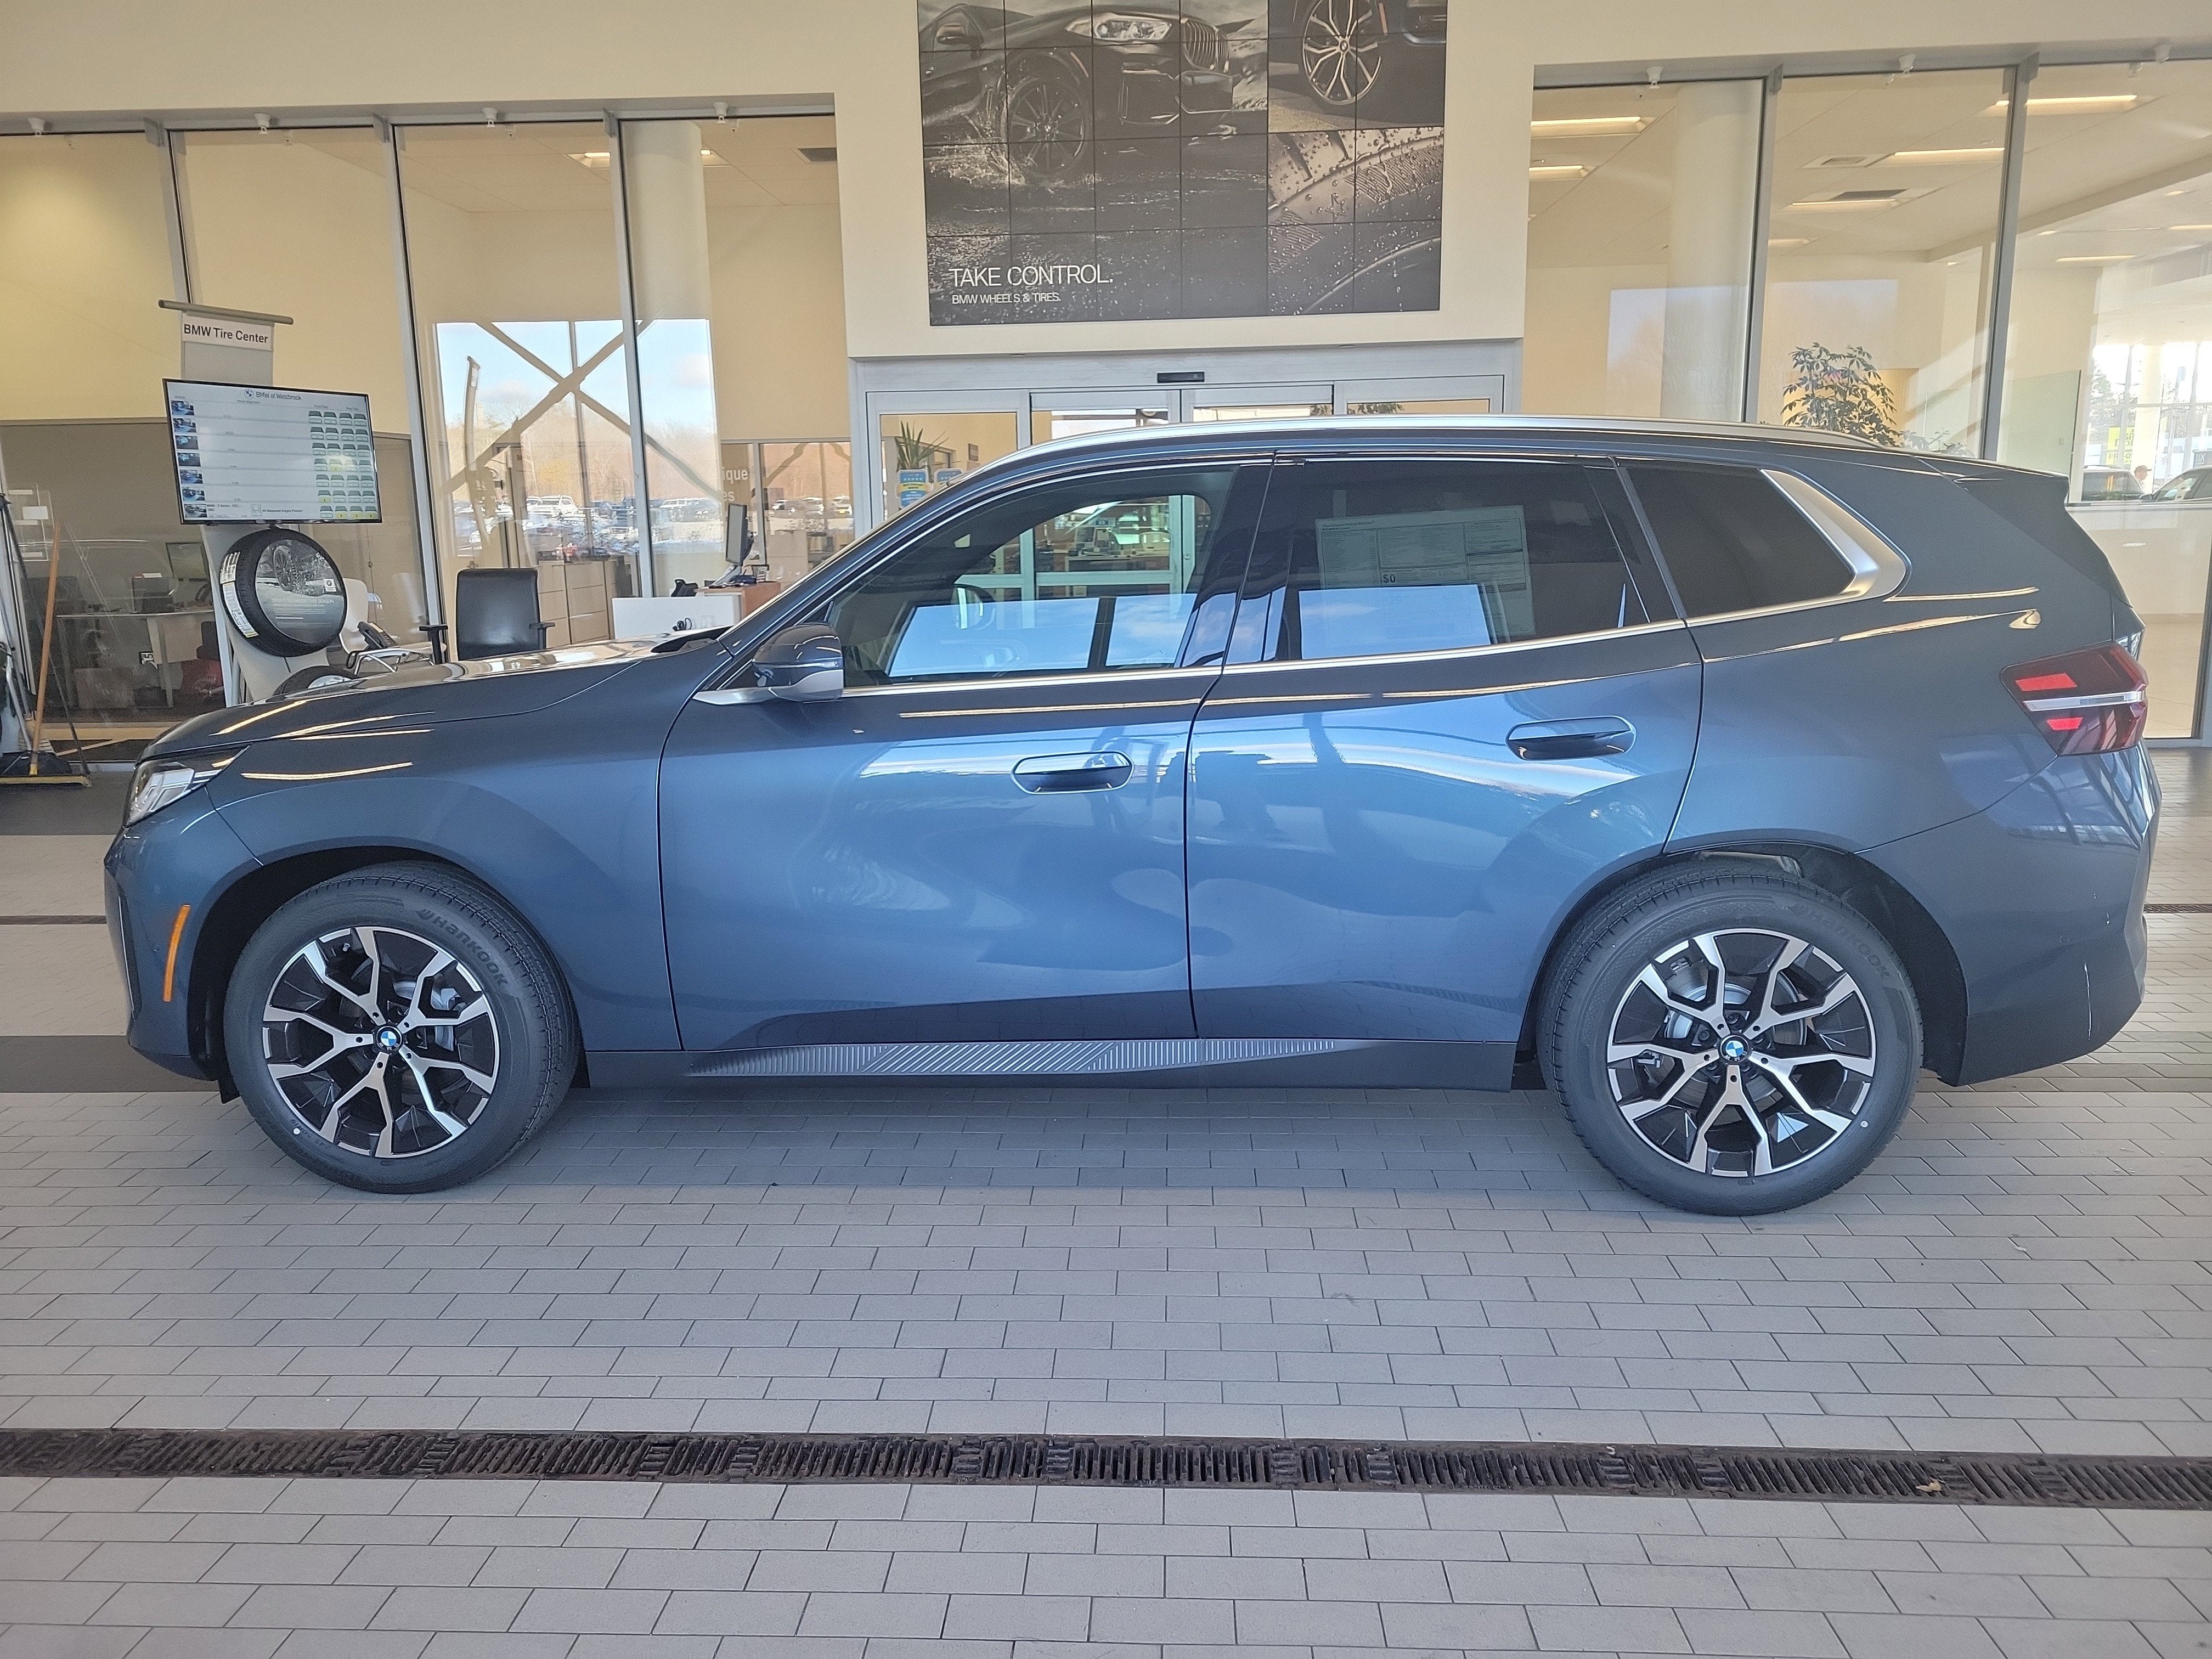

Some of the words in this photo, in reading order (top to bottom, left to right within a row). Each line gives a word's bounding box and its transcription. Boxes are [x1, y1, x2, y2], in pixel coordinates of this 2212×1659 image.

[948, 267, 1001, 287] TAKE
[1007, 264, 1113, 286] CONTROL.
[952, 294, 978, 304] BMW
[980, 293, 1020, 303] WHEELS
[1022, 293, 1031, 302] &
[1032, 292, 1061, 302] TIRES.
[184, 323, 211, 336] BMW
[213, 327, 233, 339] Tire
[235, 330, 268, 343] Center
